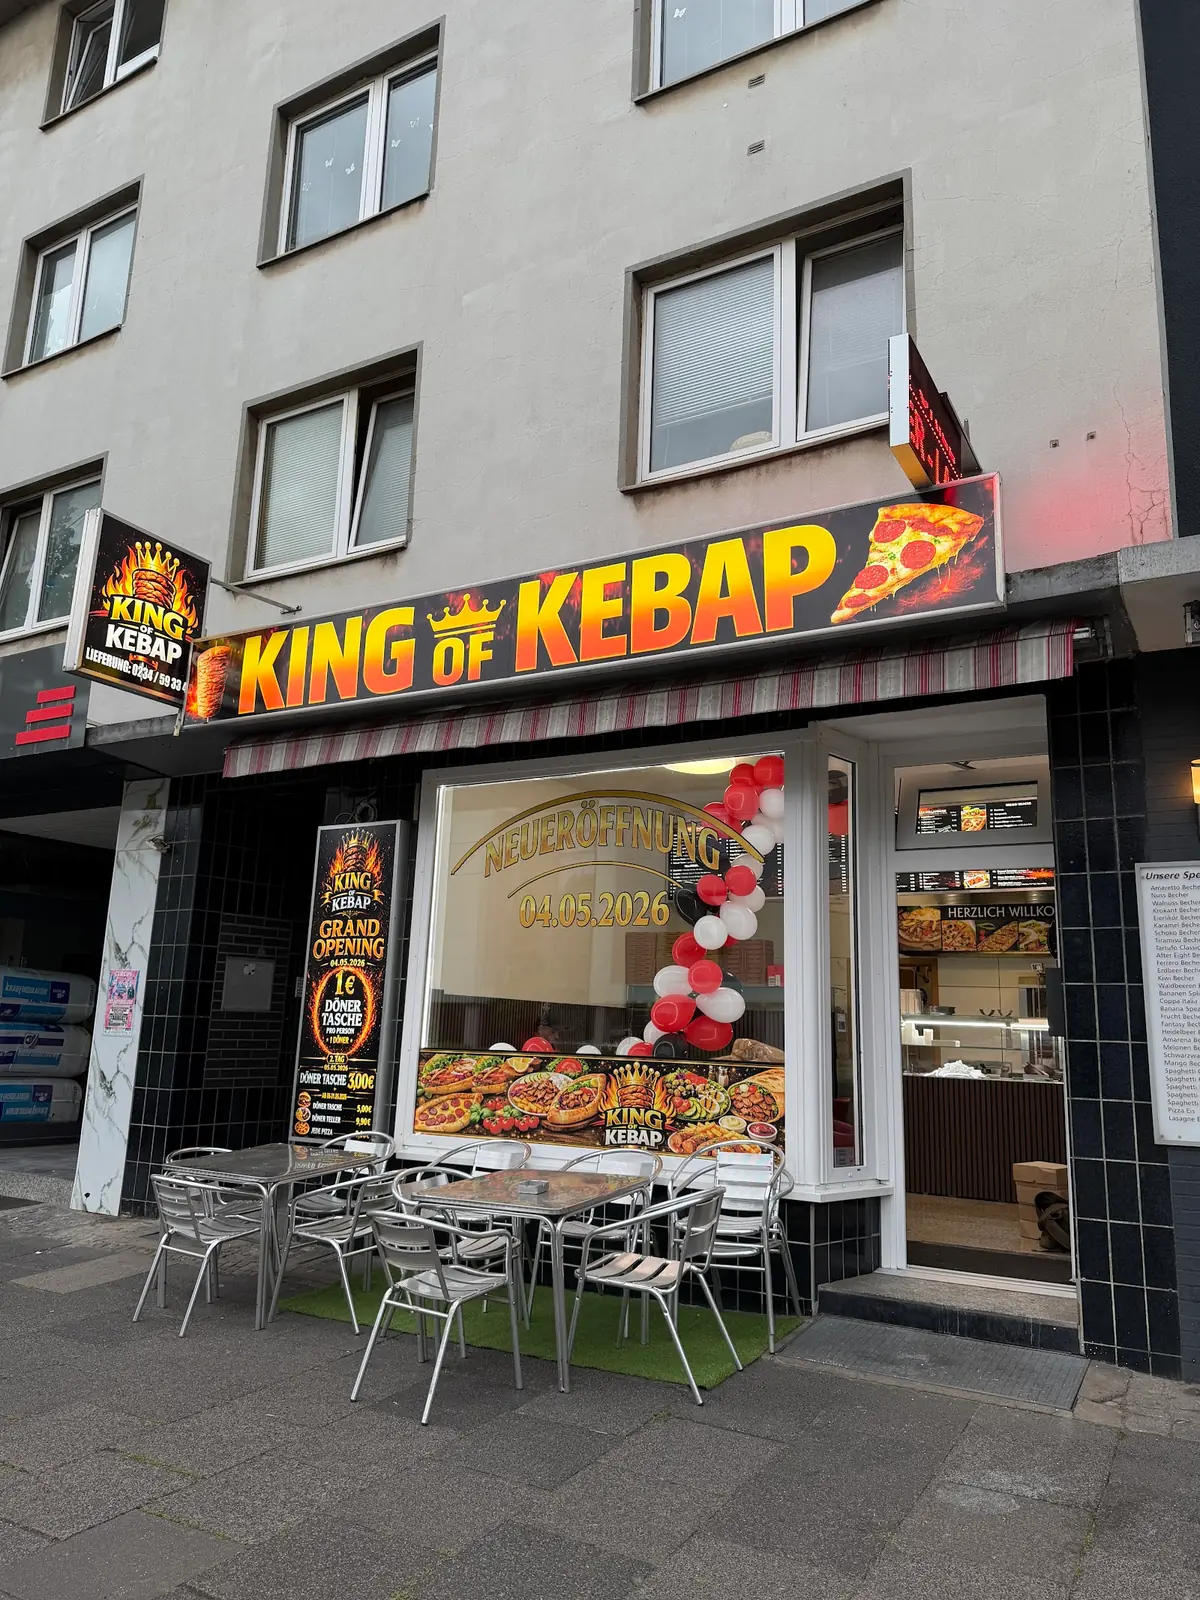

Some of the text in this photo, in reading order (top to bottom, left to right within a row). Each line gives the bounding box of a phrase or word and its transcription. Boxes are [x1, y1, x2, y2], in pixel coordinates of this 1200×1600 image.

[110, 596, 185, 641] KING
[238, 524, 838, 715] KING OF KEBAP
[139, 624, 154, 635] OF
[105, 623, 182, 665] KEBAP
[85, 646, 131, 675] LIEFERUNG:
[131, 663, 154, 681] 0234
[158, 673, 171, 688] 59
[170, 677, 181, 692] 33
[484, 799, 720, 878] NEUERÖFFNUNG
[333, 871, 372, 893] KING
[1145, 872, 1180, 880] Unsere
[348, 889, 356, 897] OF
[331, 895, 371, 913] KEBAP
[518, 890, 671, 928] 04.05.2026
[948, 905, 1055, 918] HERZLICH WILLKO
[319, 918, 381, 938] GRAND
[312, 938, 385, 960] OPENING
[329, 958, 366, 968] 04.05.2026
[335, 969, 356, 996] 1€
[324, 997, 362, 1013] DÖNER
[321, 1012, 363, 1027] TASCHE
[325, 1027, 336, 1035] PRO
[299, 1070, 375, 1091] DÖNER TASCHE 3,00€
[312, 1100, 327, 1110] DÖNER
[311, 1113, 326, 1122] DÖNER
[605, 1108, 663, 1130] KING
[604, 1129, 663, 1147] KEBAP
